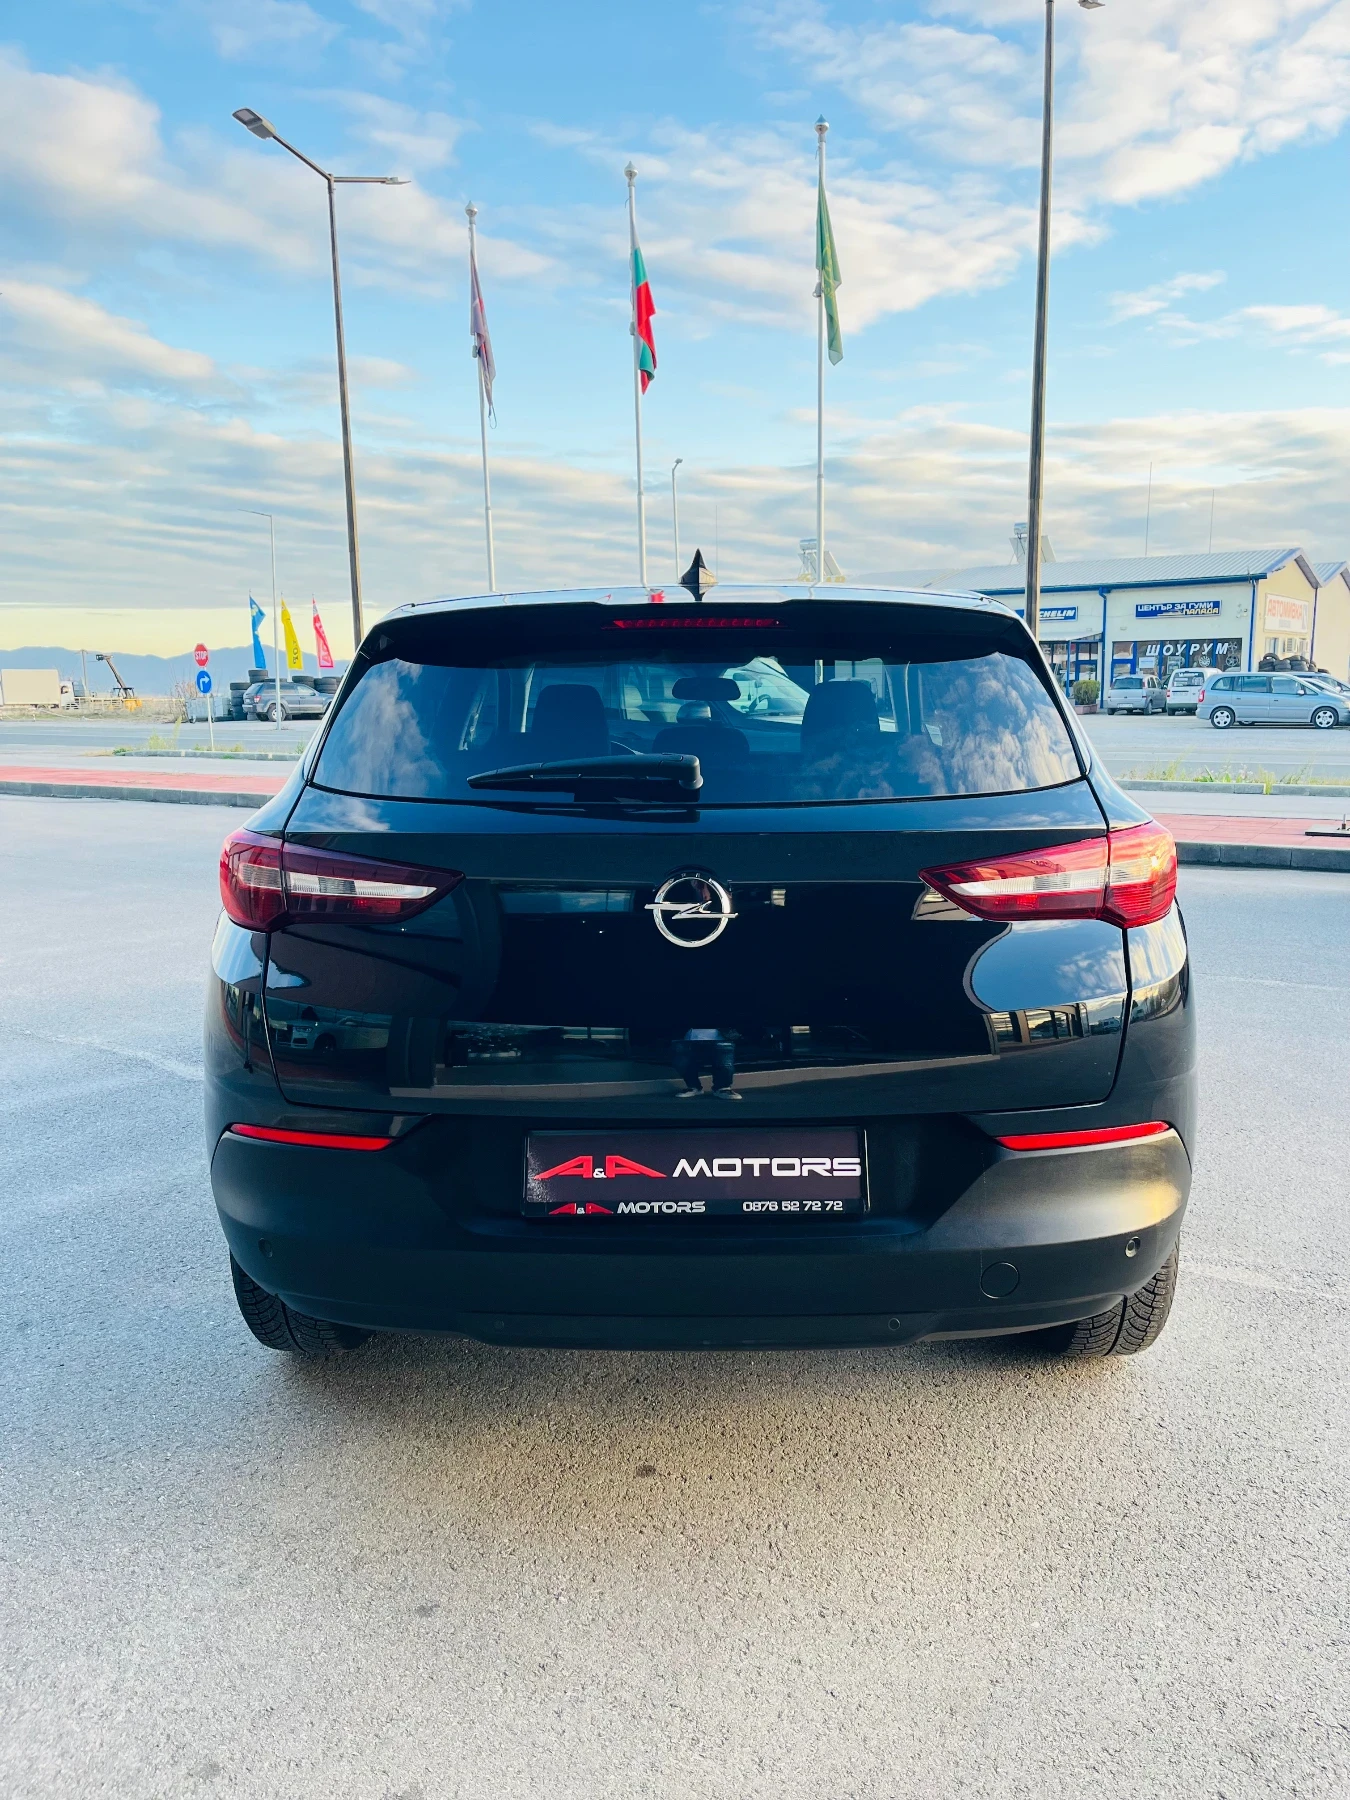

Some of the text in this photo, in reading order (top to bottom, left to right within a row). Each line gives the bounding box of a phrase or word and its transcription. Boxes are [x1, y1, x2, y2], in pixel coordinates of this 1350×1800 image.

[195, 651, 208, 660] STOP
[672, 1157, 862, 1178] MOTORS
[617, 1201, 706, 1214] MOTORS
[742, 1201, 779, 1212] 0876
[781, 1201, 800, 1212] 52
[803, 1200, 822, 1211] 72
[824, 1200, 844, 1211] 72
